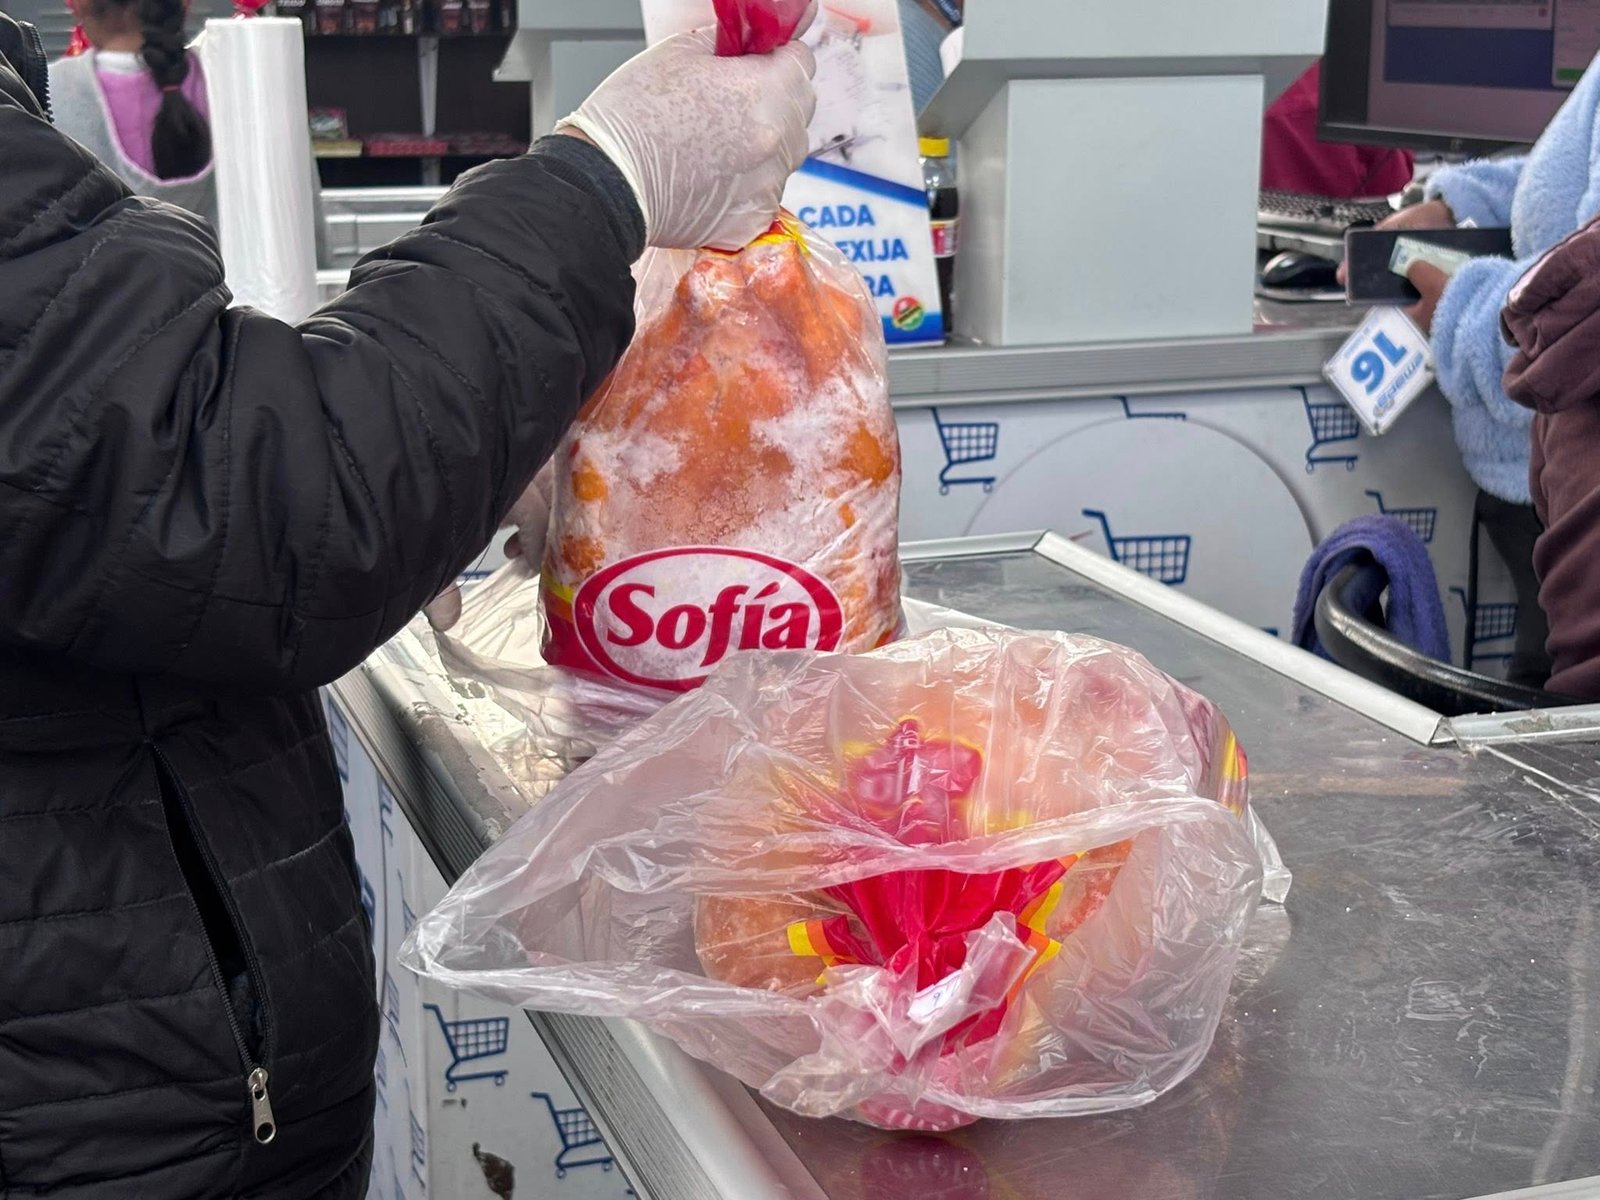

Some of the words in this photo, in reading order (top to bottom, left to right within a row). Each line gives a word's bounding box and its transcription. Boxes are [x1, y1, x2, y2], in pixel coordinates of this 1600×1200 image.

[798, 204, 875, 228] CADA
[1351, 331, 1407, 393] 16
[606, 582, 811, 667] Sofía
